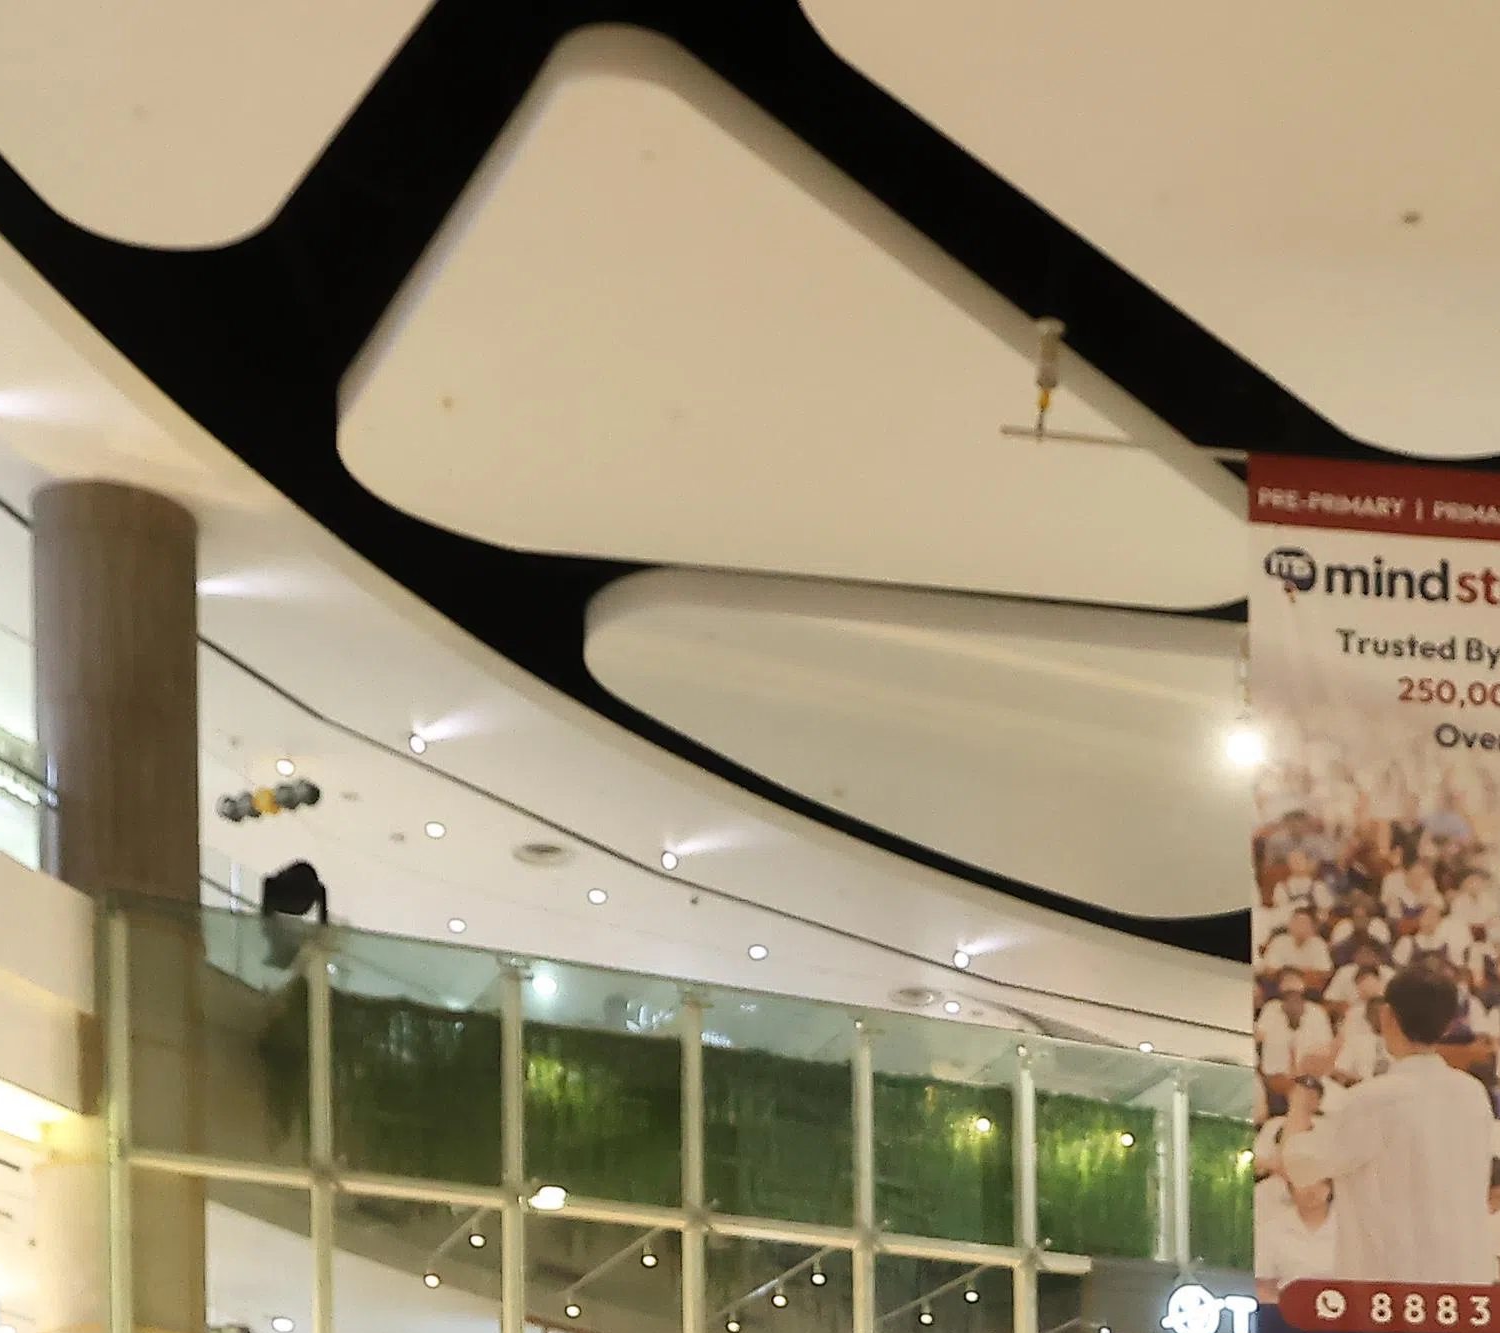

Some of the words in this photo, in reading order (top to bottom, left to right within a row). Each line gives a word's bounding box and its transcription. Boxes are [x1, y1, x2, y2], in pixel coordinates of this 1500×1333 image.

[1257, 487, 1404, 517] PRE-PRIMARY
[1336, 628, 1456, 663] Trusted
[1466, 636, 1500, 671] By
[1370, 1291, 1493, 1328] 8883
